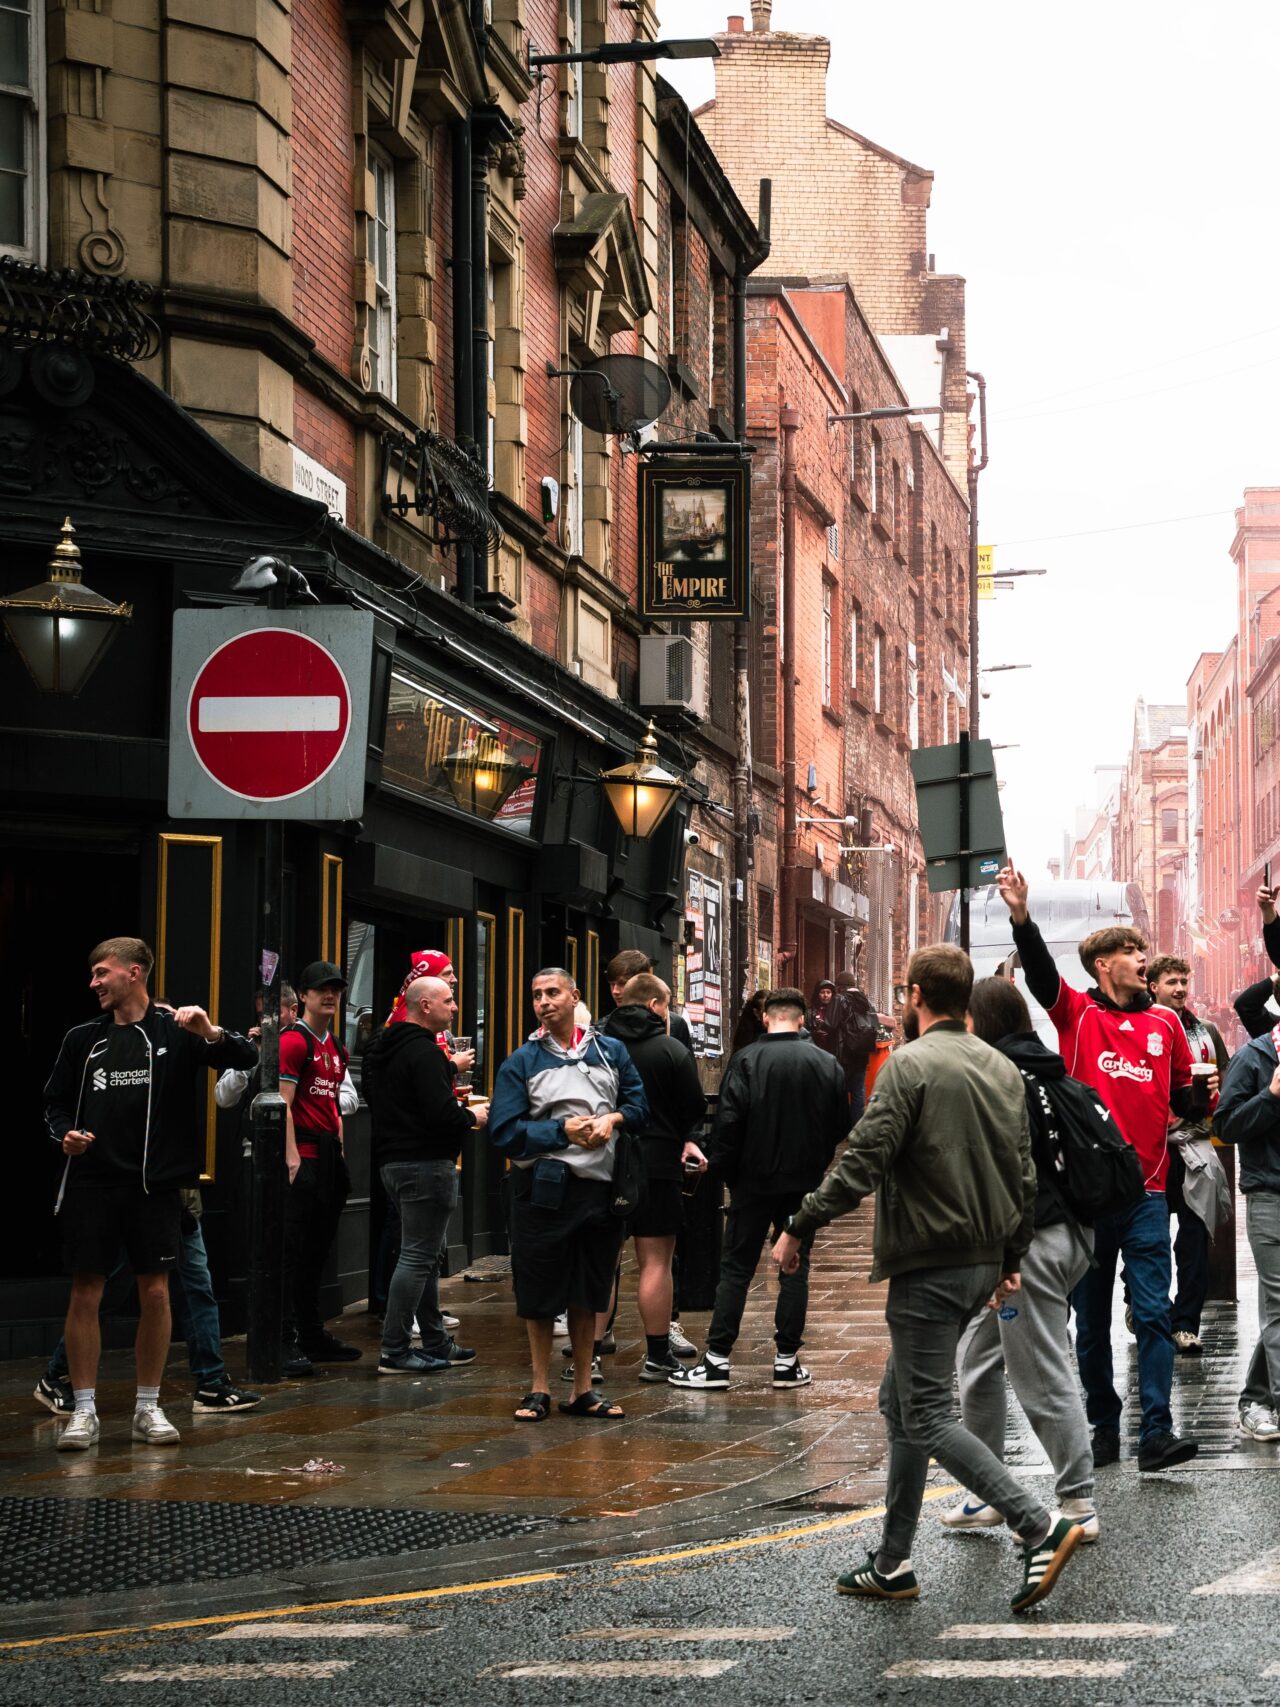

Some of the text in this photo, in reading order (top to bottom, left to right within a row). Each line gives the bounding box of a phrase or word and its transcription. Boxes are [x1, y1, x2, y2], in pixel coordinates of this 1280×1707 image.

[294, 460, 339, 511] WOOD STREET
[654, 561, 676, 577] THE
[662, 575, 727, 600] EMPIRE
[424, 698, 454, 777] THE
[110, 1069, 150, 1079] standar
[1098, 1050, 1154, 1082] Carlsberg
[110, 1077, 150, 1086] chartere
